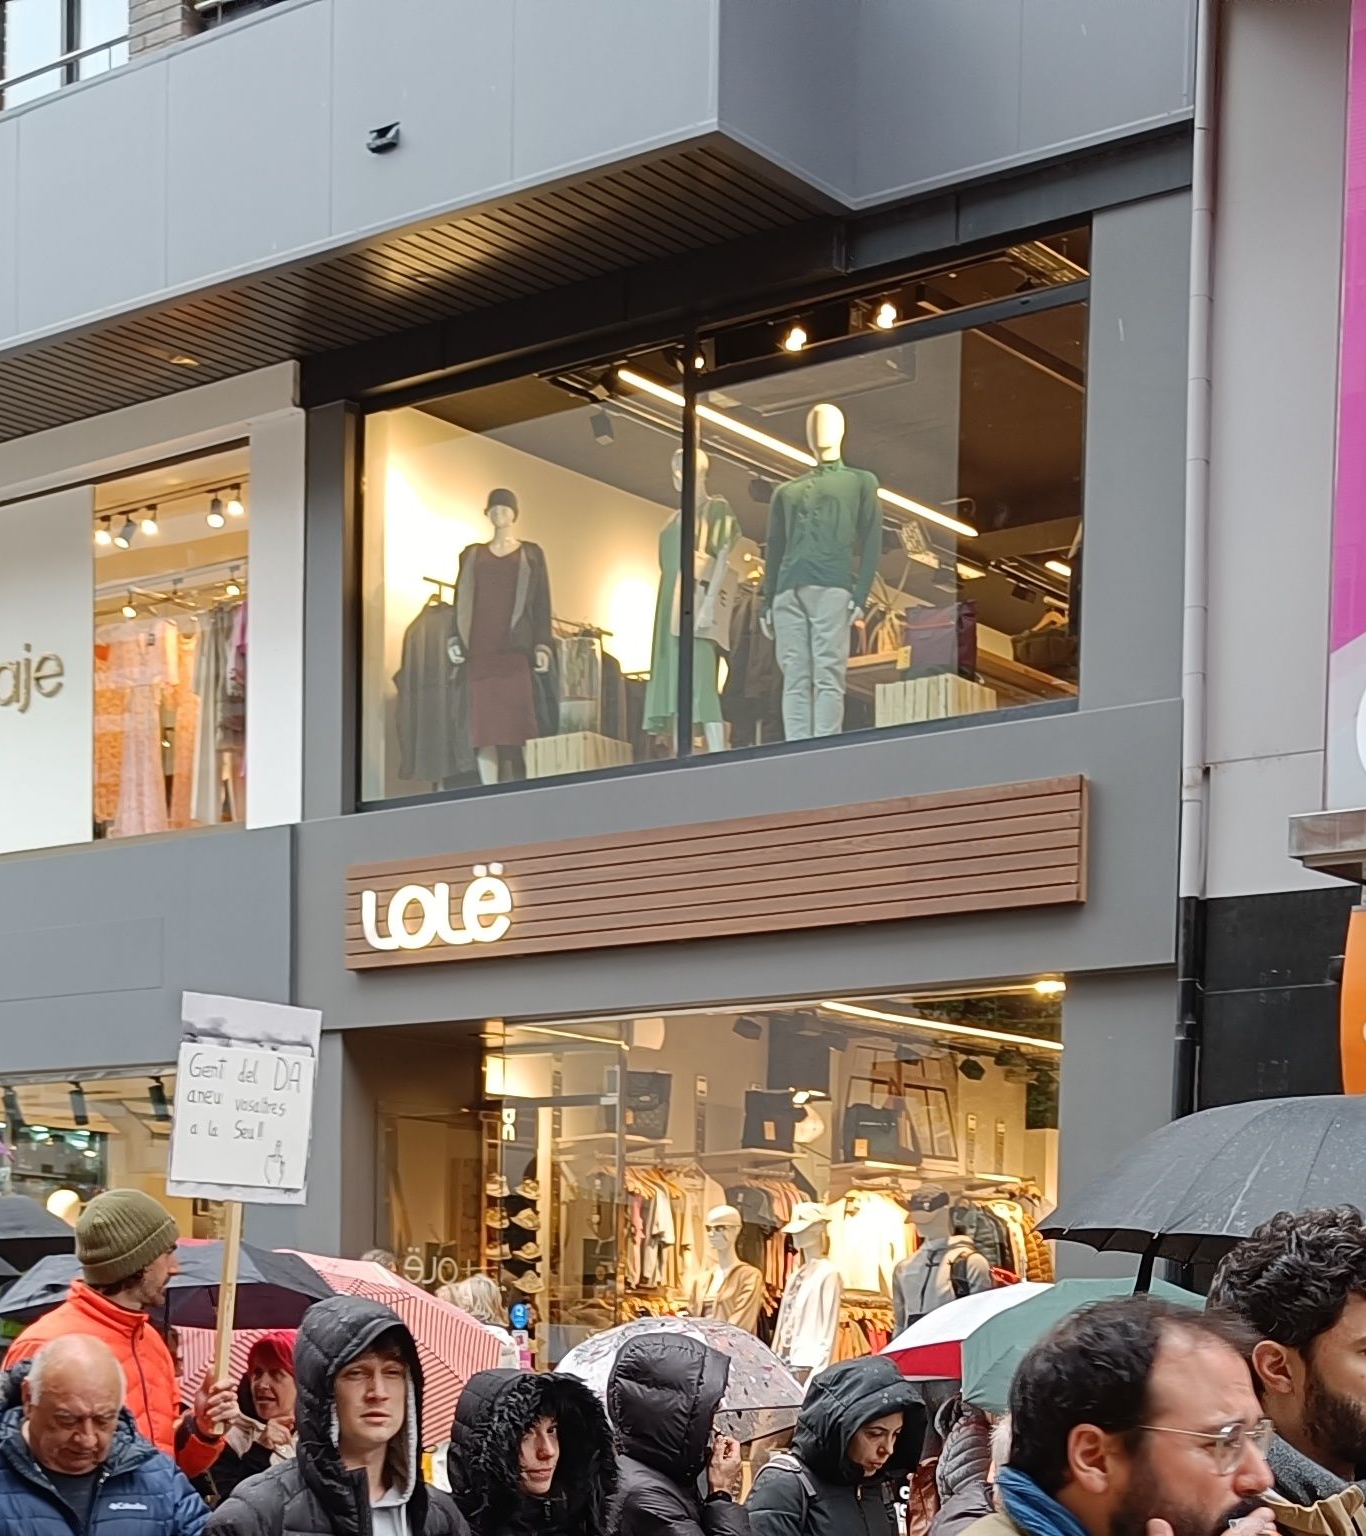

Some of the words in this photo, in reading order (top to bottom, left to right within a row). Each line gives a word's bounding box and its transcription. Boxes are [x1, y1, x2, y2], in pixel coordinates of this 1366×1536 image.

[189, 1052, 227, 1080] Gent
[237, 1058, 259, 1085] del
[273, 1056, 302, 1093] DA
[187, 1089, 223, 1105] aneu
[190, 1123, 198, 1135] a
[208, 1120, 219, 1137] la
